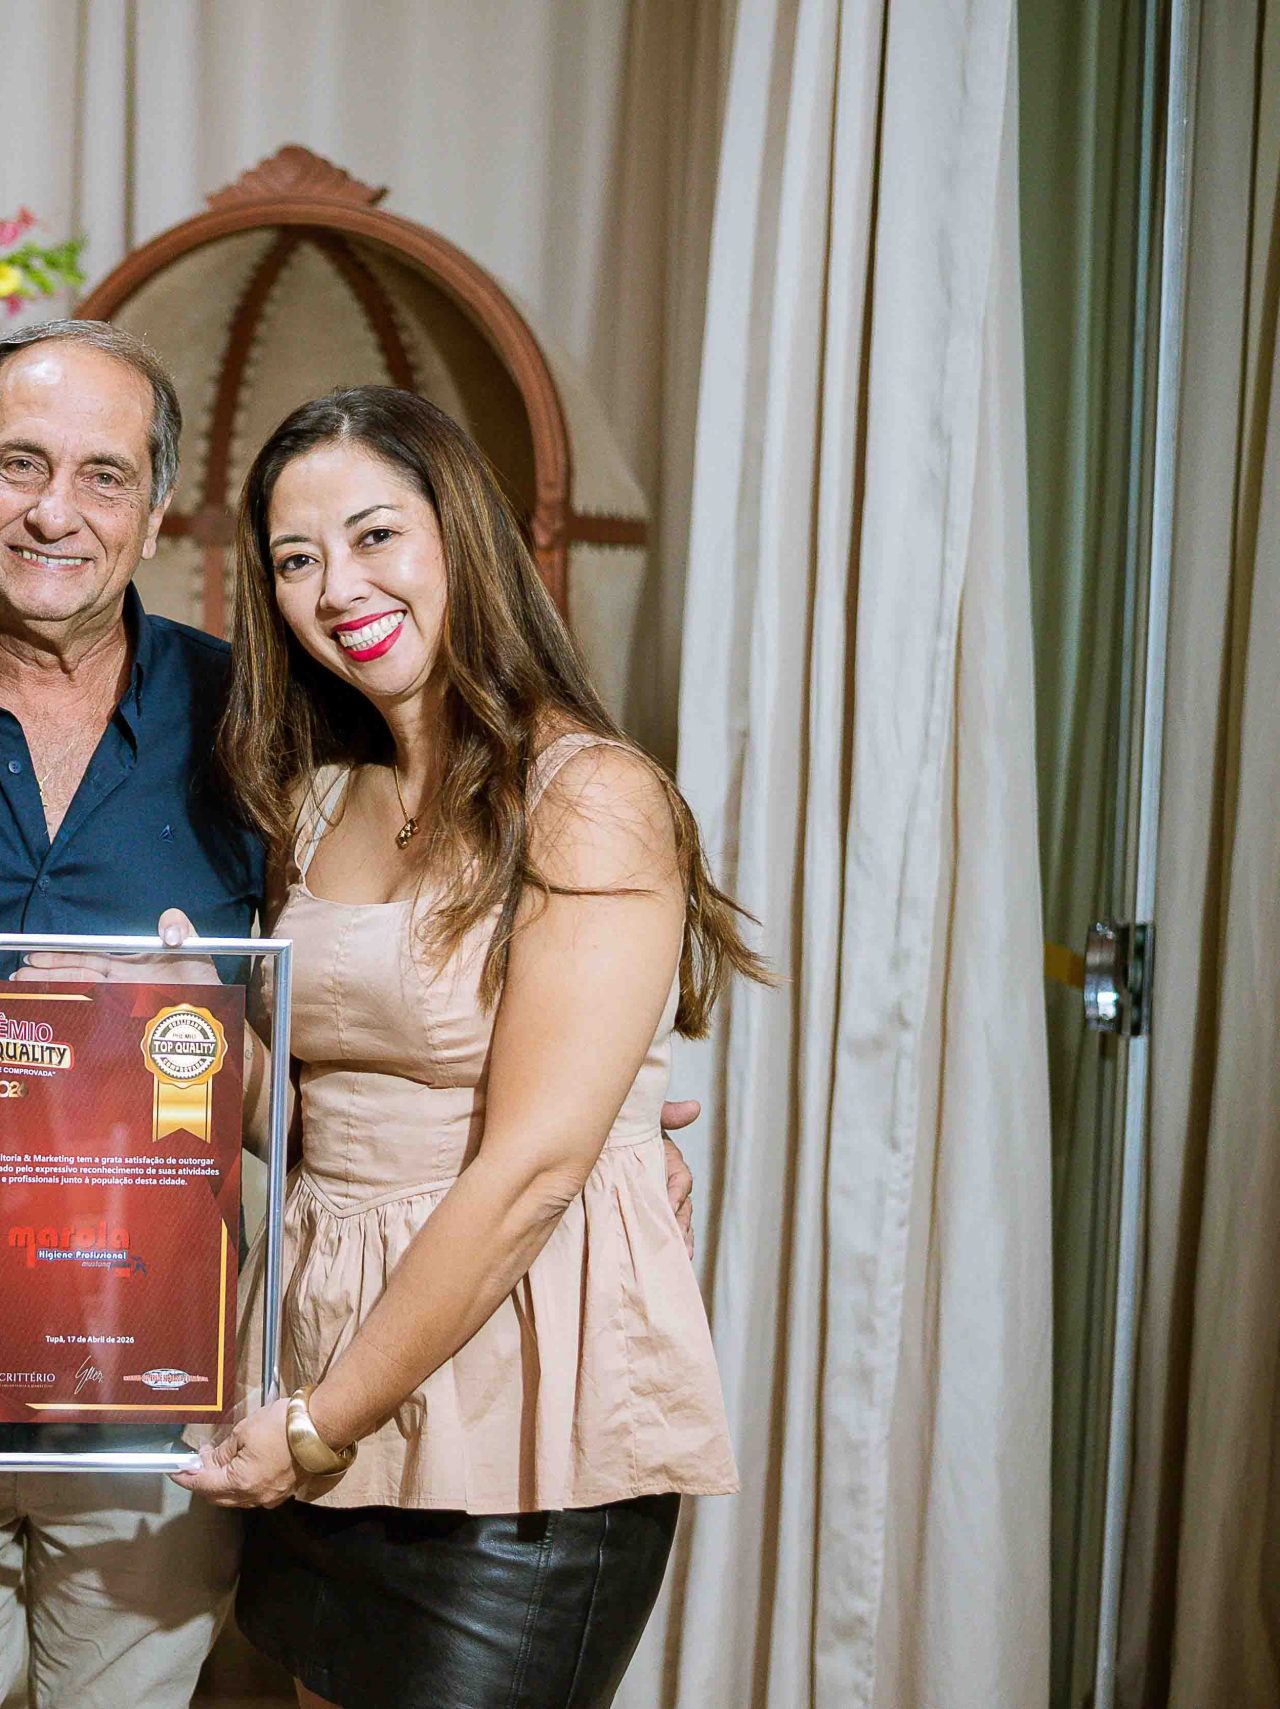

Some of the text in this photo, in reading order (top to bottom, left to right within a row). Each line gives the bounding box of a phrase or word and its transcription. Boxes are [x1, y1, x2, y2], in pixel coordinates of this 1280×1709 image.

[153, 1041, 215, 1054] TOP QUALITY
[24, 1154, 31, 1162] &
[33, 1154, 74, 1165] Marketing
[101, 1156, 122, 1166] grata
[124, 1155, 165, 1166] satisfação
[166, 1156, 177, 1165] de
[178, 1157, 215, 1167] outorgar
[15, 1164, 34, 1174] pelo
[35, 1165, 78, 1174] expressivo
[80, 1165, 145, 1175] reconhecimento
[146, 1166, 156, 1175] de
[158, 1168, 176, 1176] suas
[177, 1167, 220, 1177] atividades
[8, 1174, 59, 1184] profissionais
[60, 1175, 82, 1185] junto
[85, 1175, 90, 1184] à
[91, 1176, 134, 1187] população
[135, 1176, 157, 1185] desta
[159, 1177, 188, 1186] cidade.
[8, 1220, 131, 1268] marola
[38, 1250, 127, 1260] Higiene Profissional
[67, 1335, 76, 1343] 17
[76, 1336, 86, 1344] de
[87, 1336, 105, 1344] Abril
[106, 1336, 116, 1344] de
[117, 1336, 135, 1344] 2026
